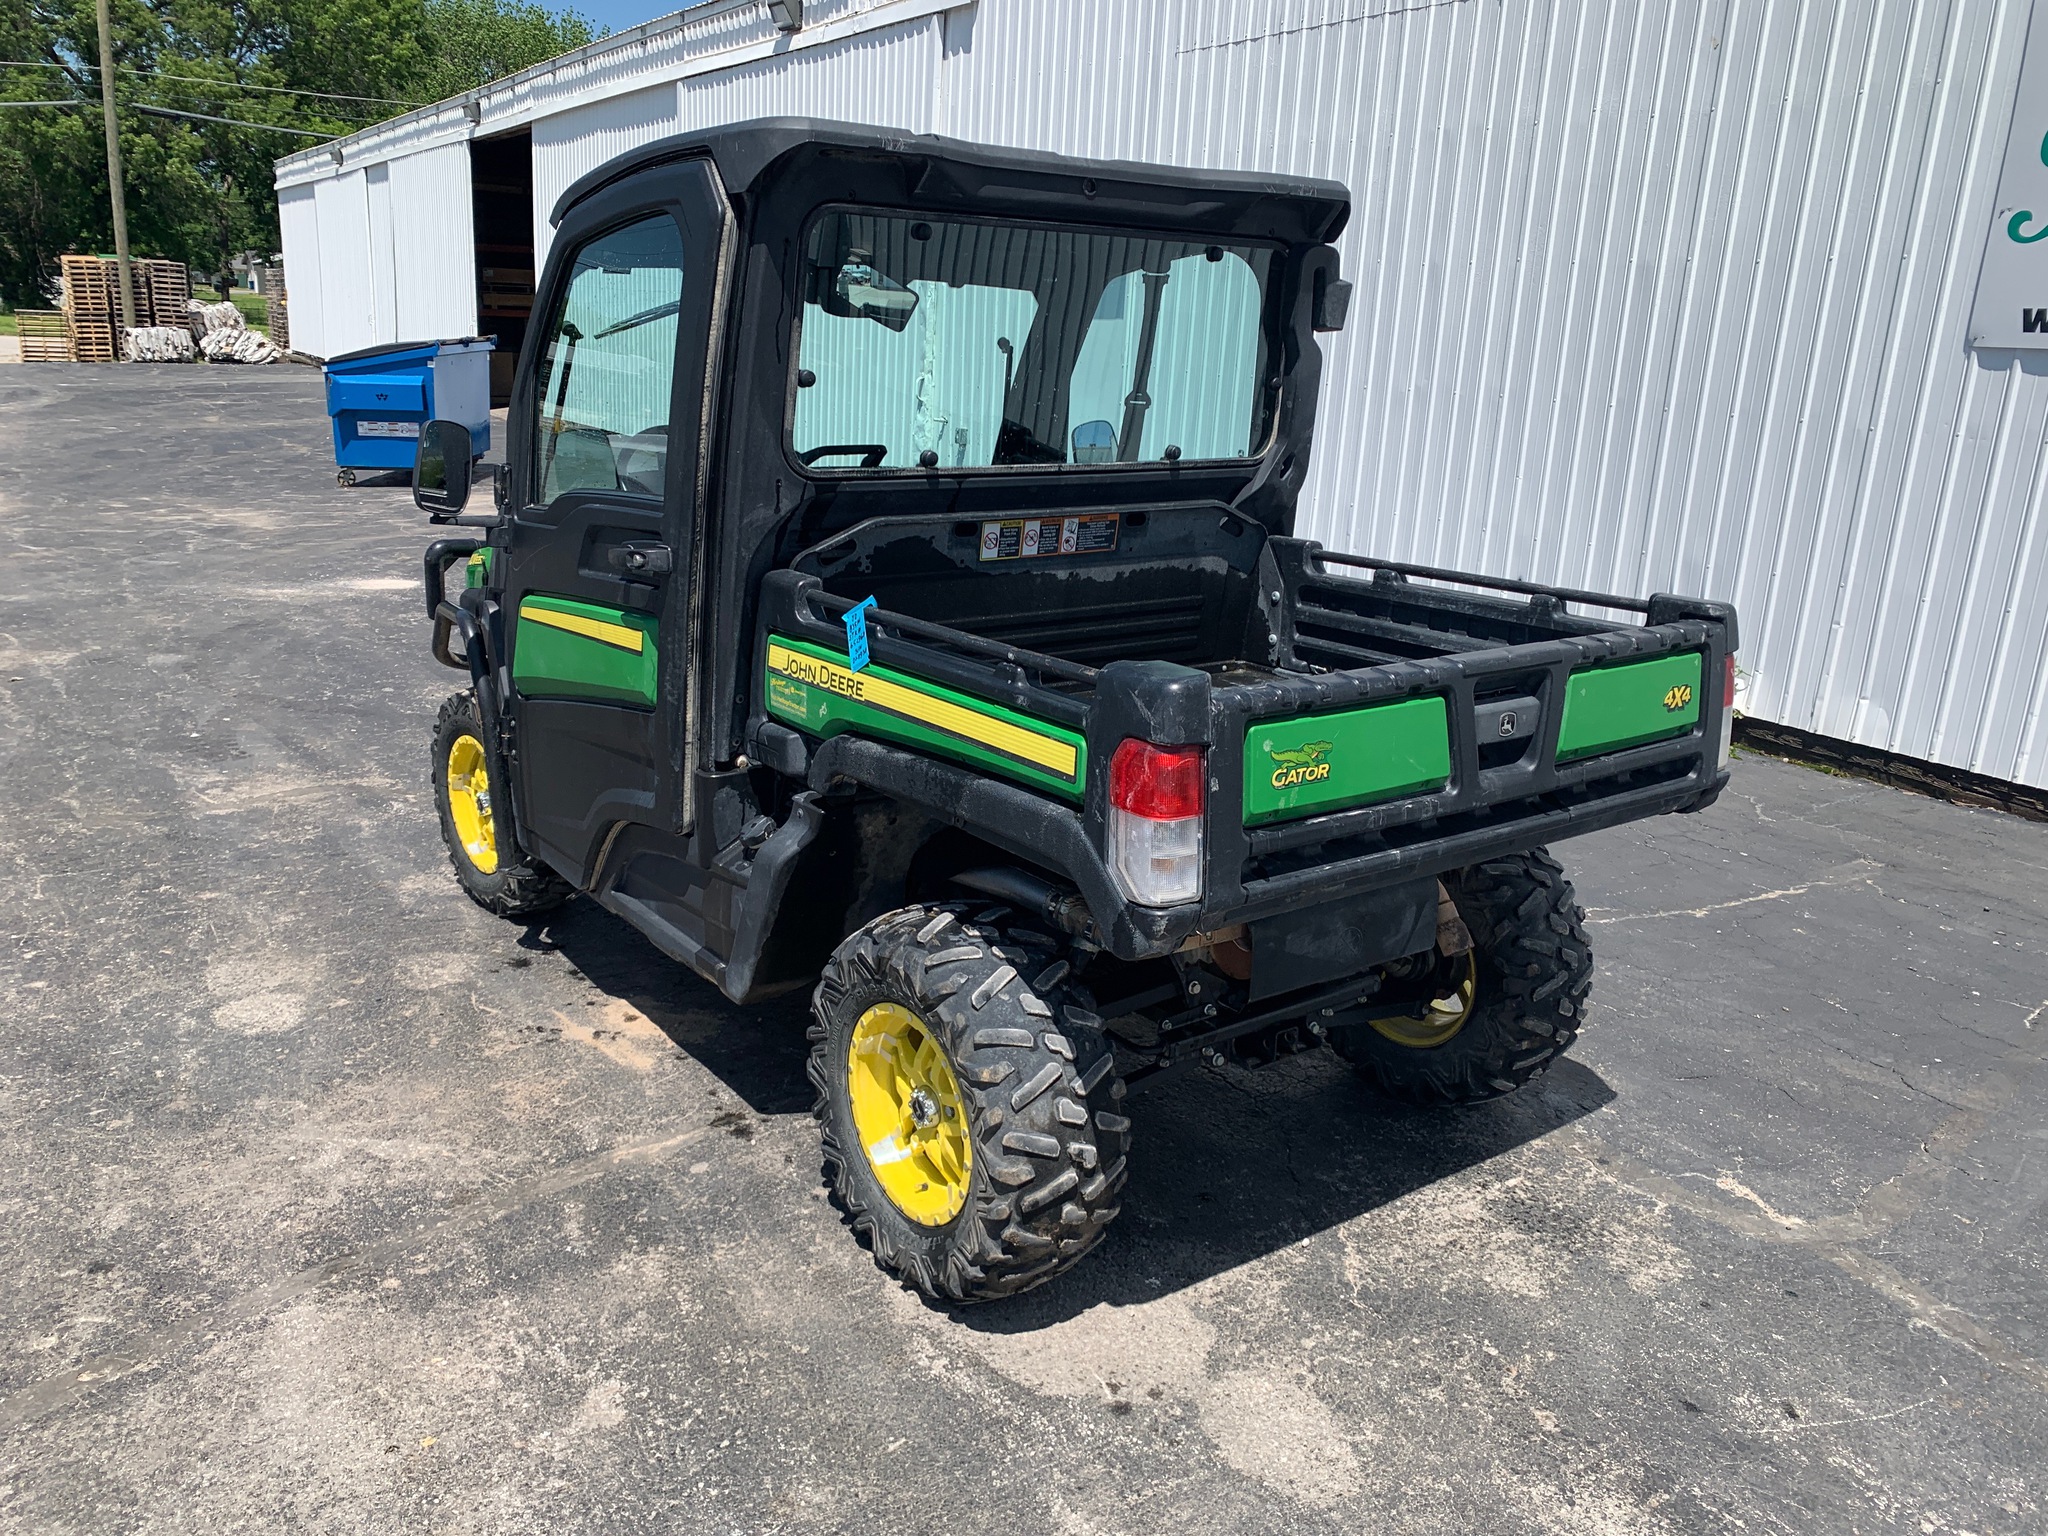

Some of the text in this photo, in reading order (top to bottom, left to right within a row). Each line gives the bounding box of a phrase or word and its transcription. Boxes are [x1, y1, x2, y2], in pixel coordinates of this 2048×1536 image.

[783, 654, 864, 698] JOHN DEERE
[1663, 685, 1692, 709] 4X4
[1271, 763, 1330, 788] GATOR
